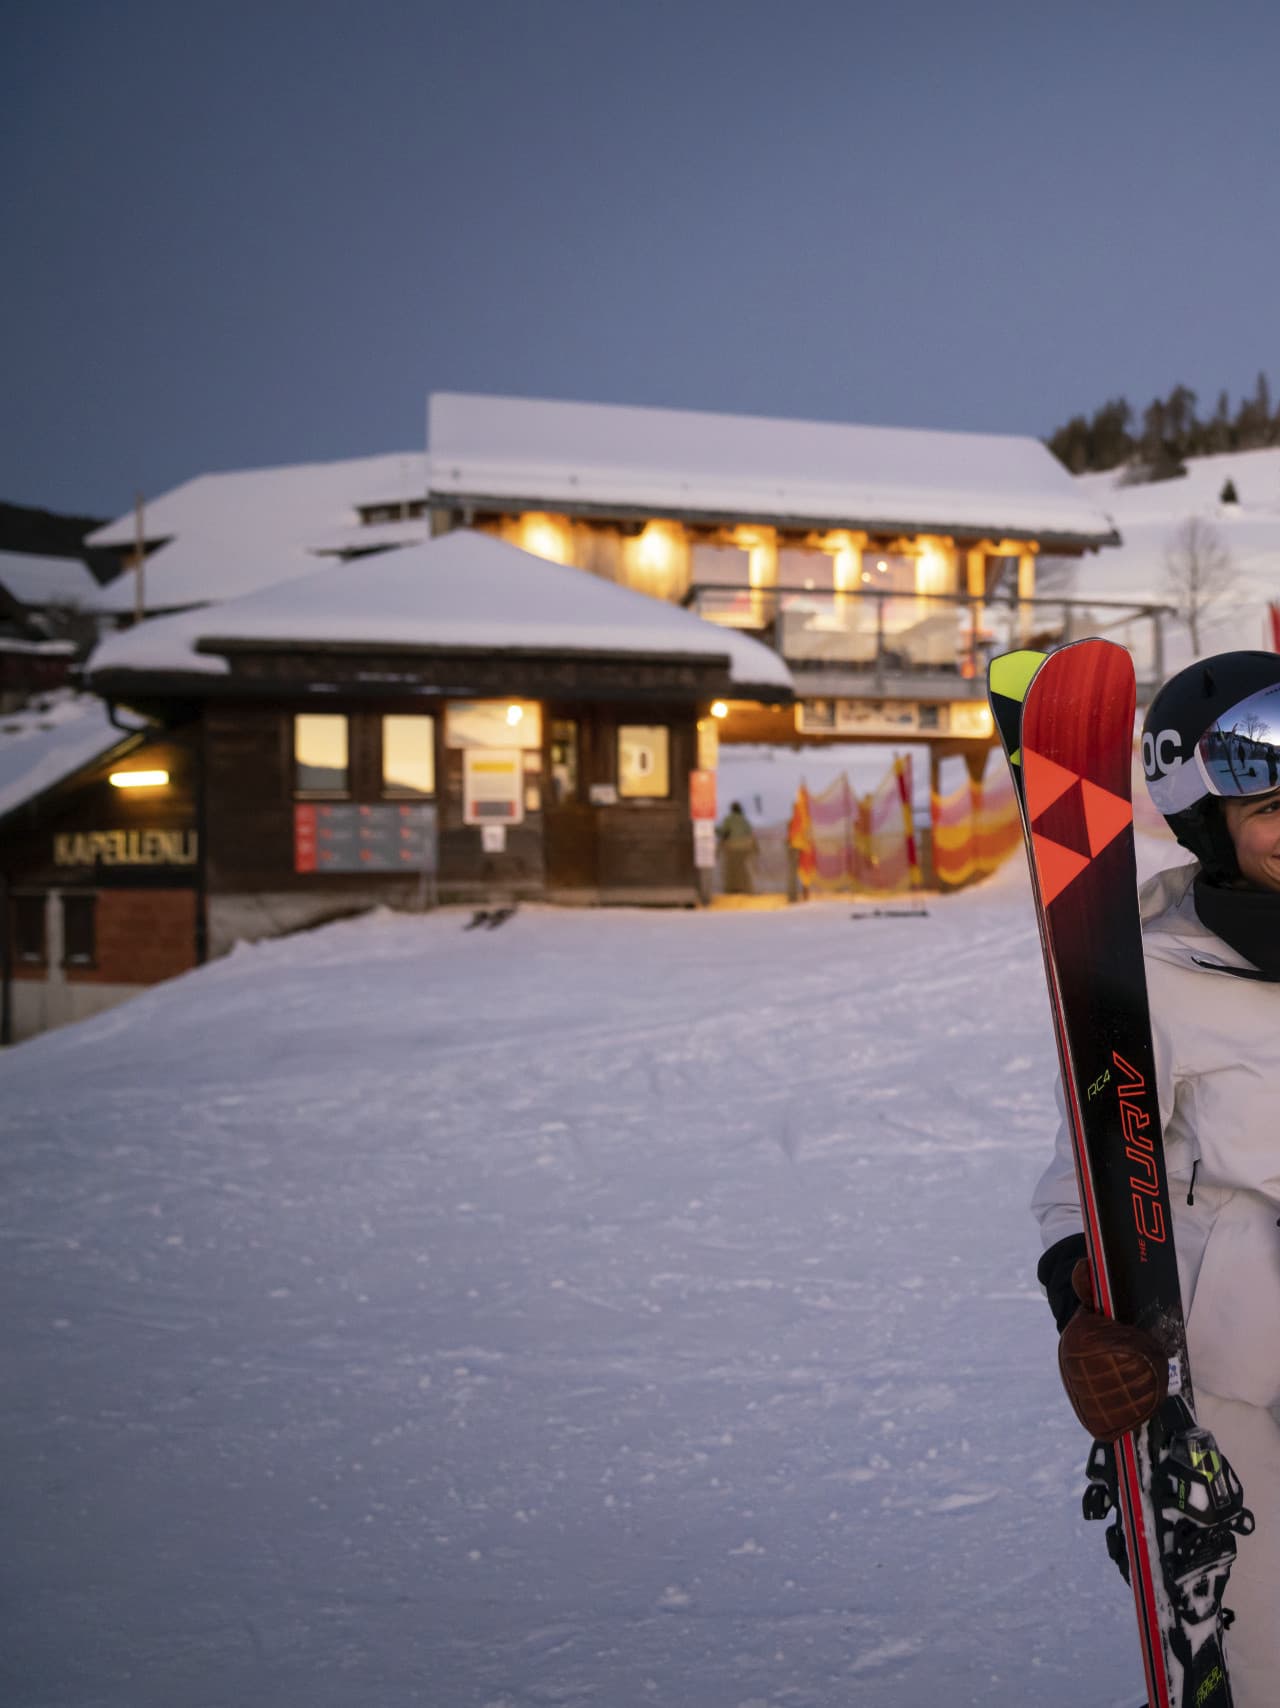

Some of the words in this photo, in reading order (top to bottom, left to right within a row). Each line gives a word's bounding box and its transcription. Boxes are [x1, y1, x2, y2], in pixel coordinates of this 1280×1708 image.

[1088, 1069, 1111, 1101] RC4
[1112, 1050, 1166, 1242] CURV
[1138, 1238, 1148, 1263] THE
